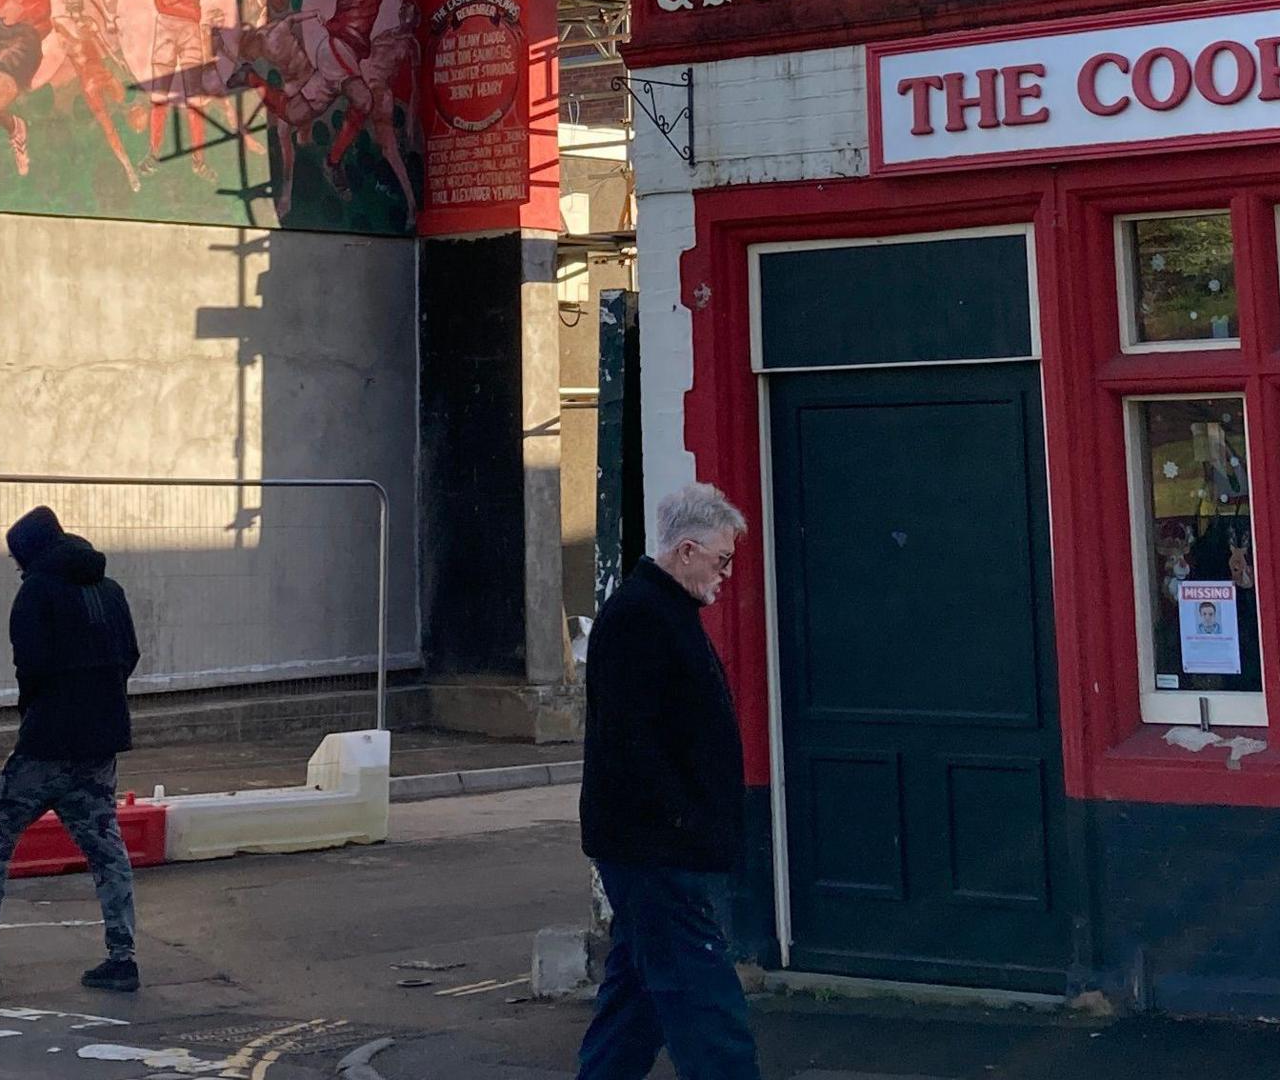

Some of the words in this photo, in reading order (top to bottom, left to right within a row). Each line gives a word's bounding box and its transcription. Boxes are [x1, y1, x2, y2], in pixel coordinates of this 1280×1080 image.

[432, 6, 448, 23] THE
[456, 3, 497, 22] REMEMBER
[897, 62, 1050, 137] THE
[1184, 587, 1231, 599] MISSING
